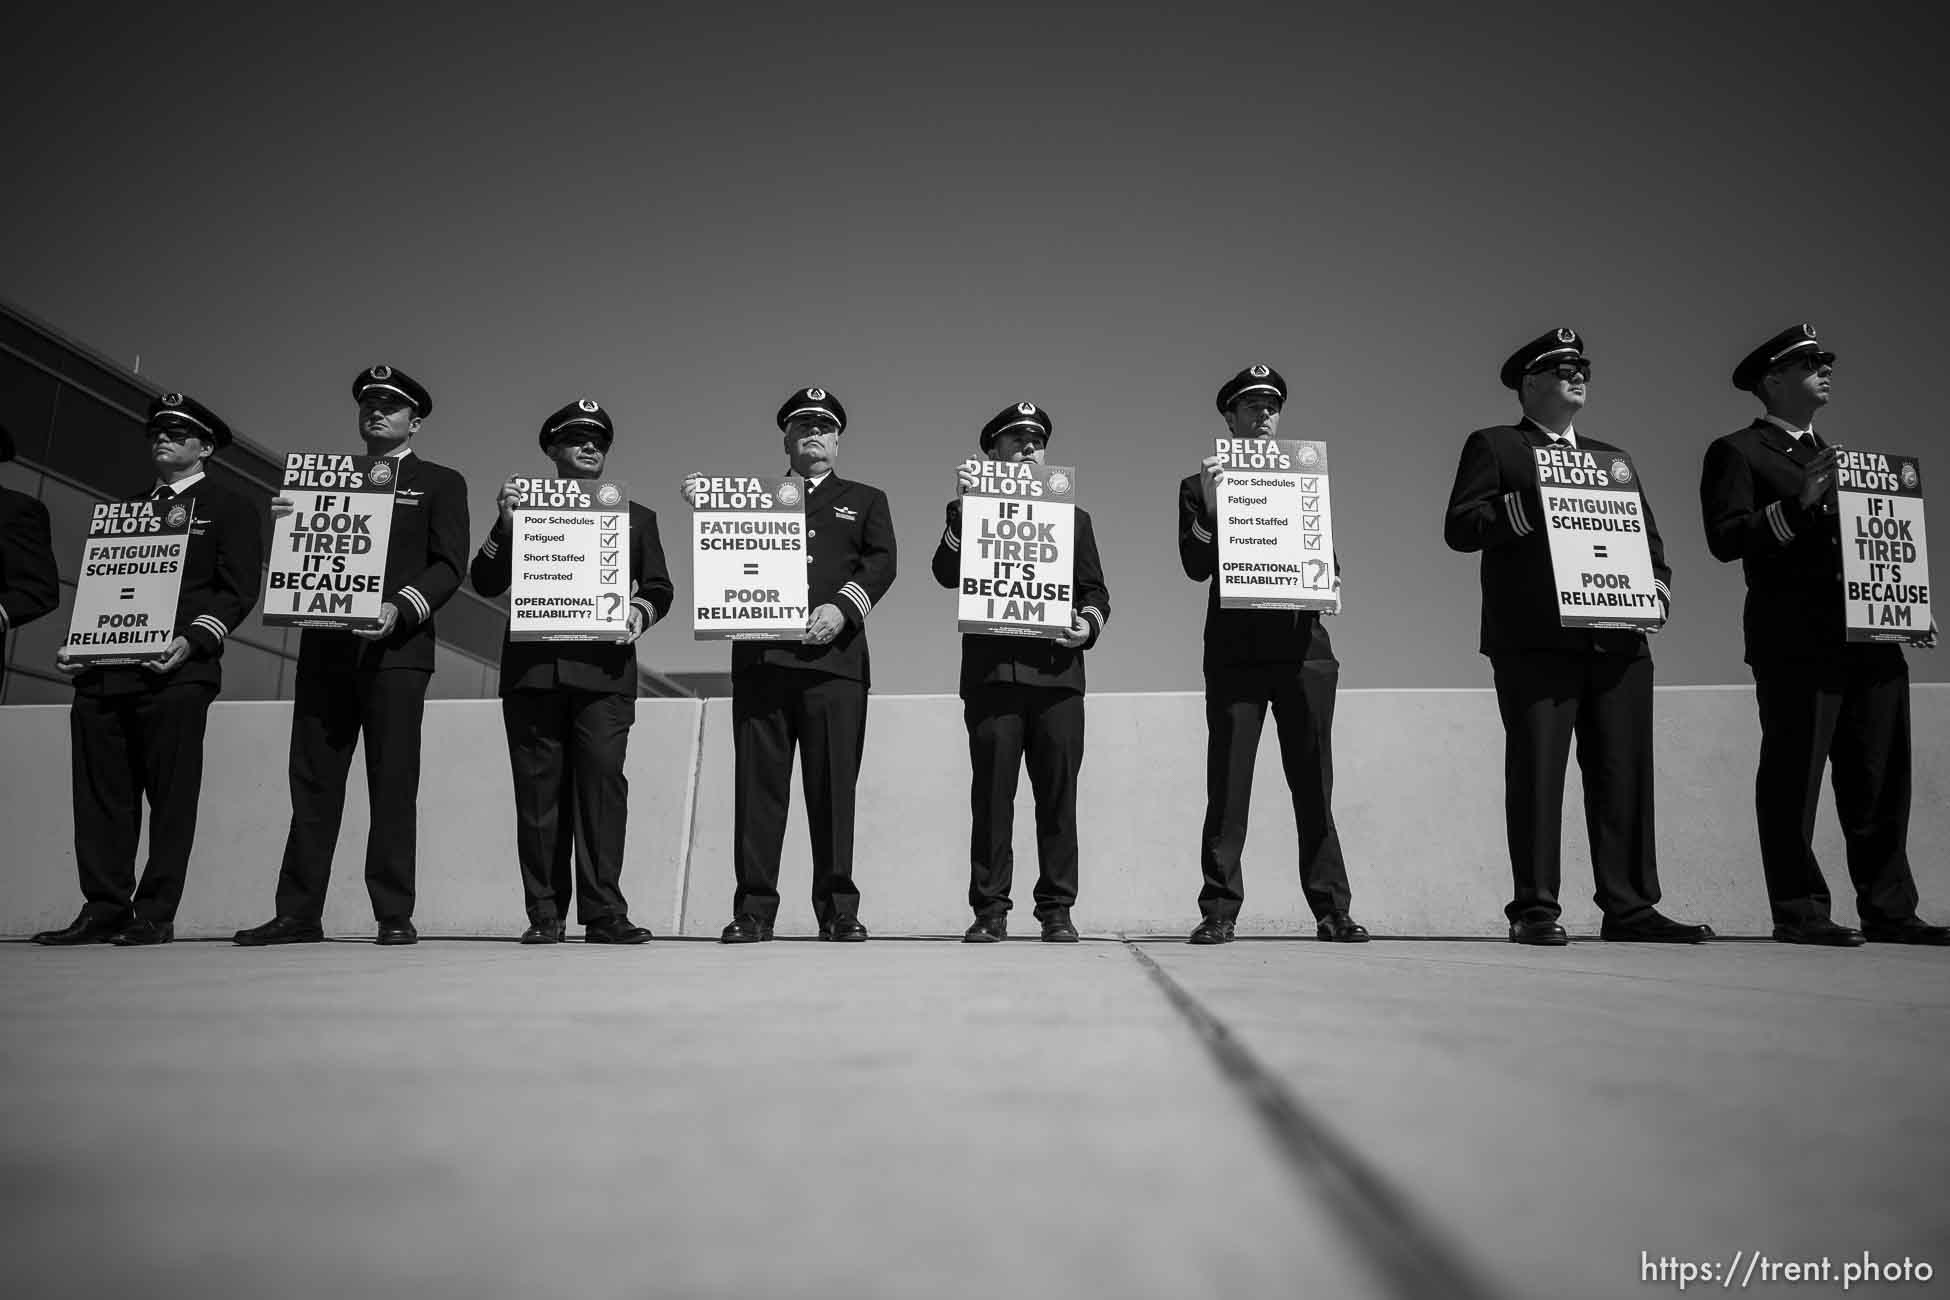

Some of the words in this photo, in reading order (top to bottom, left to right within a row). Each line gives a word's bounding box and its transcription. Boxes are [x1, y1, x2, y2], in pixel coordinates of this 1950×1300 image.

[1216, 439, 1280, 454] DELTA
[286, 453, 354, 472] DELTA
[1217, 453, 1290, 469] PILOTS
[1536, 449, 1597, 469] DELTA
[1836, 451, 1890, 472] DELTA
[966, 460, 1032, 480] DELTA
[1538, 466, 1609, 486] PILOTS
[283, 470, 363, 488] PILOTS
[515, 479, 581, 494] DELTA
[695, 478, 762, 493] DELTA
[1227, 478, 1249, 486] Poor
[1251, 479, 1295, 487] Schedules
[1838, 469, 1899, 491] PILOTS
[315, 495, 336, 512] IF
[343, 496, 350, 512] I
[695, 493, 773, 509] PILOTS
[1228, 496, 1267, 506] Fatigued
[1548, 497, 1637, 515] FATIGUING
[1868, 498, 1883, 517] IF
[1889, 500, 1894, 517] I
[93, 502, 154, 519] DELTA
[1000, 502, 1019, 519] IF
[1027, 504, 1032, 520] I
[89, 517, 161, 535] PILOTS
[294, 512, 372, 534] LOOK
[524, 516, 547, 524] Poor
[549, 517, 595, 526] Schedules
[700, 521, 800, 535] FATIGUING
[1229, 517, 1253, 525] Short
[1256, 517, 1288, 526] Staffed
[1552, 516, 1641, 532] SCHEDULES
[1856, 516, 1913, 541] LOOK
[524, 534, 565, 543] Fatigued
[981, 518, 1056, 543] LOOK
[289, 533, 372, 554] TIRED
[700, 538, 801, 551] SCHEDULES
[1229, 537, 1277, 545] Frustrated
[89, 544, 181, 560] FATIGUING
[524, 554, 552, 562] Short
[551, 554, 585, 562] Staffed
[977, 538, 1058, 563] TIRED
[1855, 538, 1916, 563] TIRED
[86, 561, 178, 576] SCHEDULES
[302, 555, 346, 573] IT’S
[993, 562, 1035, 581] IT’S
[1223, 562, 1300, 572] OPERATIONAL
[524, 572, 573, 581] Frustrated
[1226, 575, 1298, 585] RELIABILITY?
[1581, 573, 1631, 589] POOR
[1870, 563, 1901, 583] IT’S
[270, 572, 380, 592] BECAUSE
[962, 578, 1070, 601] BECAUSE
[724, 589, 780, 603] POOR
[1561, 592, 1656, 607] RELIABILITY
[1848, 582, 1928, 604] BECAUSE
[292, 592, 301, 612] I
[307, 593, 353, 614] AM
[515, 597, 594, 606] OPERATIONAL
[517, 609, 592, 619] RELIABILITY?
[697, 607, 807, 619] RELIABILITY
[987, 599, 994, 618] I
[1002, 600, 1045, 622] AM
[1868, 603, 1874, 625] I
[1880, 604, 1912, 626] AM
[98, 614, 149, 628] POOR
[70, 630, 170, 645] RELIABILITY
